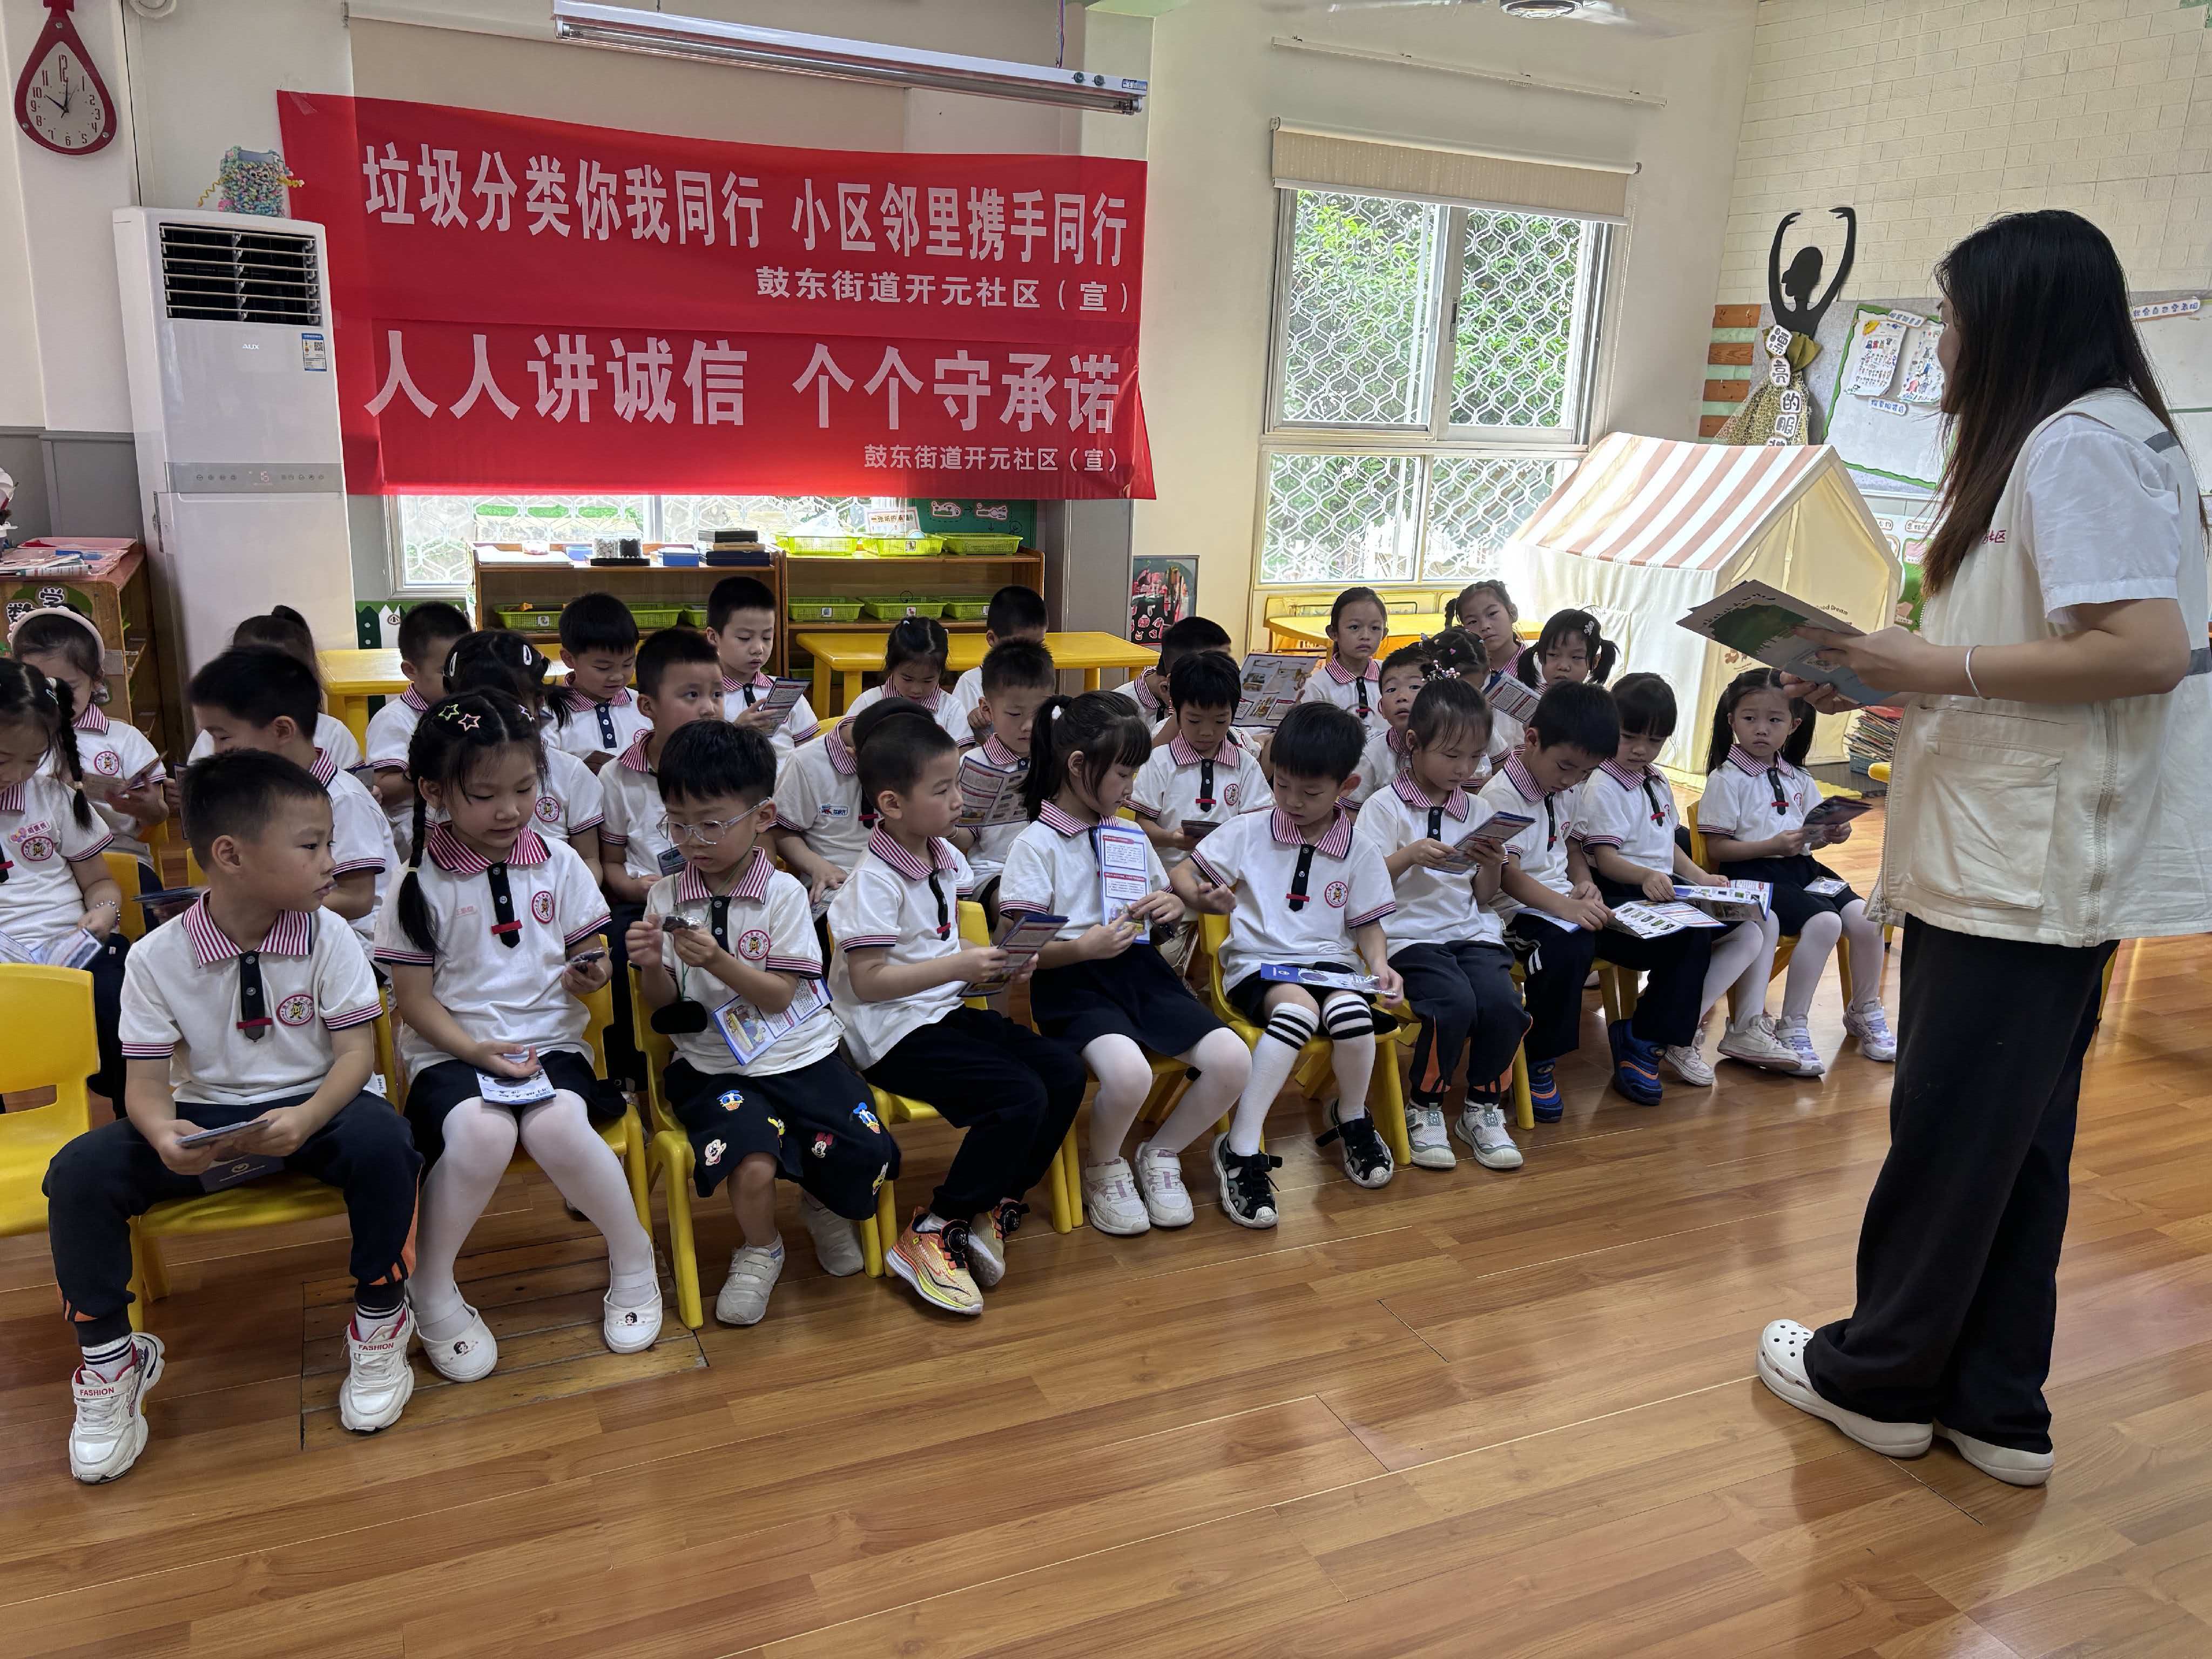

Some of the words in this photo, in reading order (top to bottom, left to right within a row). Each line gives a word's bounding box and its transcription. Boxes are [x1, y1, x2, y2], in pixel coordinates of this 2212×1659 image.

[58, 54, 69, 83] 12
[42, 70, 49, 86] 11
[82, 76, 85, 91] 1
[32, 87, 42, 98] 10
[30, 100, 37, 112] 9
[89, 95, 96, 106] 2
[95, 109, 100, 120] 3
[36, 115, 42, 127] 8
[91, 122, 97, 133] 4
[48, 129, 54, 140] 7
[81, 133, 87, 144] 5
[65, 136, 71, 146] 6
[362, 141, 763, 248] 垃圾分类你我同行
[792, 178, 1127, 267] 小区邻里携手同行
[757, 266, 1128, 313] 鼓东街道开元社区（宣）
[363, 329, 748, 426] 人人讲诚信
[792, 342, 1120, 434] 个个守承诺
[864, 444, 1118, 472] 鼓东街道开元社区（宣）
[1831, 605, 1848, 615] Dream
[359, 1343, 394, 1351] FASHION
[80, 1387, 114, 1396] FASHION
